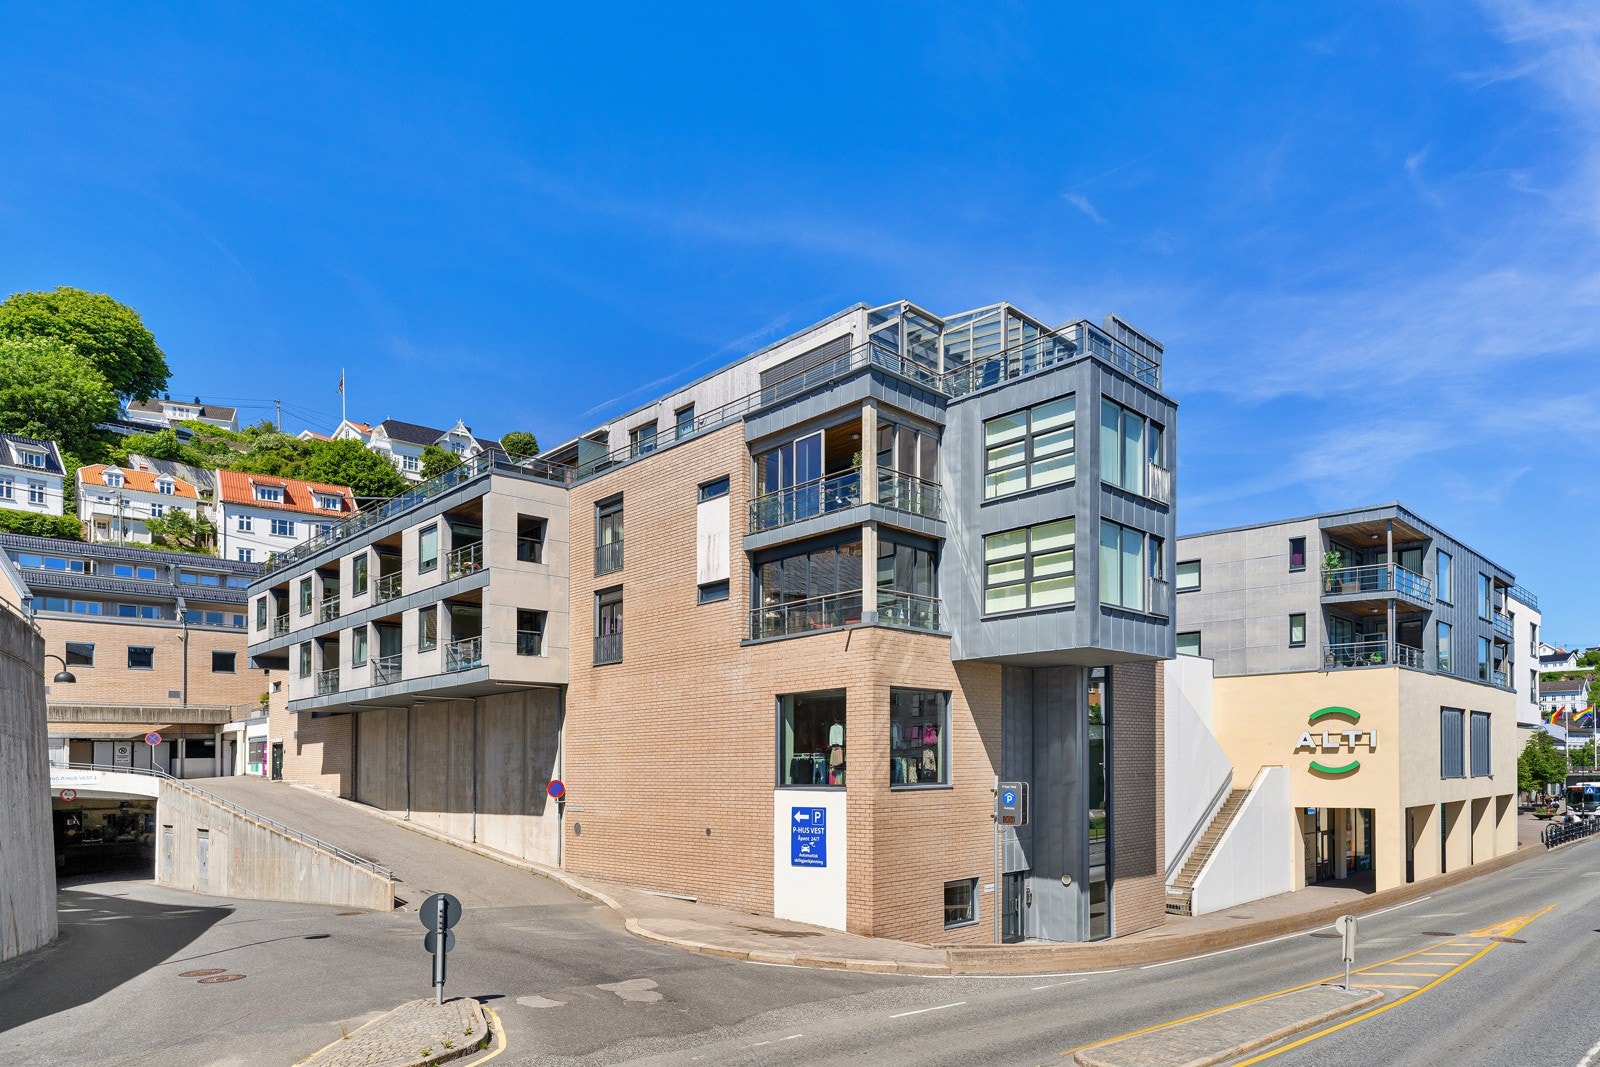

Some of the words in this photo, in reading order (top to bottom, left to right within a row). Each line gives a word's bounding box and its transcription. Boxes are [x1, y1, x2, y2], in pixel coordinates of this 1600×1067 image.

[1294, 729, 1377, 749] ALTI
[814, 812, 821, 823] P
[810, 827, 825, 835] VEST
